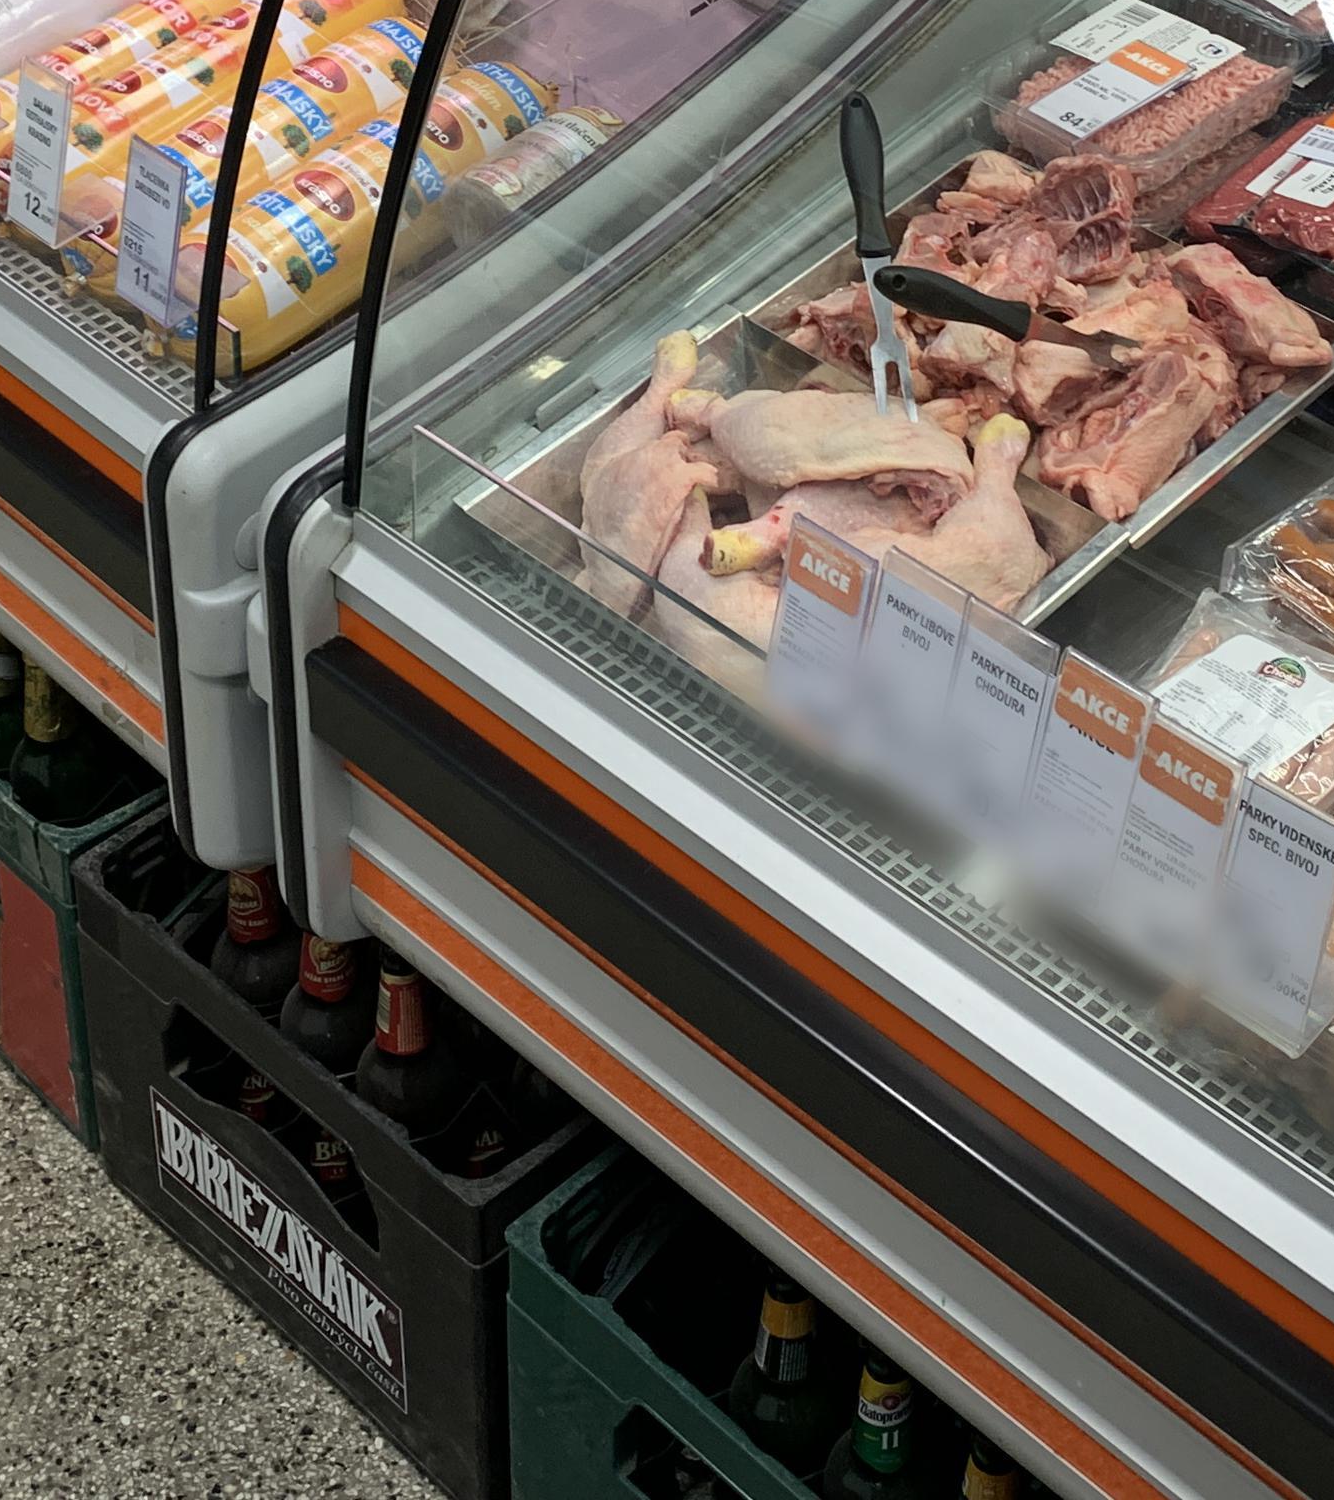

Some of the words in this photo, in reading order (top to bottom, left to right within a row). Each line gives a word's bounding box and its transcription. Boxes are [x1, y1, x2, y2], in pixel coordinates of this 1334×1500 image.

[1126, 52, 1171, 75] AKCE
[1059, 111, 1084, 128] 84
[24, 191, 41, 217] 12
[296, 177, 342, 216] krasno
[133, 266, 150, 293] 11
[799, 551, 851, 595] AKCE
[886, 592, 920, 623] PARKY
[919, 615, 956, 648] LIBOVE
[901, 624, 931, 652] BIVOJ
[971, 650, 1006, 680] PARKY
[1005, 672, 1040, 703] TELECI
[974, 675, 1026, 718] CHODURA
[1069, 686, 1131, 735] AKCE
[1155, 750, 1219, 801] AKCE
[1239, 798, 1278, 831] PARKY
[1247, 826, 1283, 858] SPEC.
[1284, 846, 1321, 877] BIVOJ
[154, 1100, 394, 1368] BŘEZŇÁK
[266, 1266, 299, 1305] Pivo
[302, 1301, 364, 1362] dobrých
[366, 1357, 403, 1400] časů
[881, 1429, 901, 1451] 11
